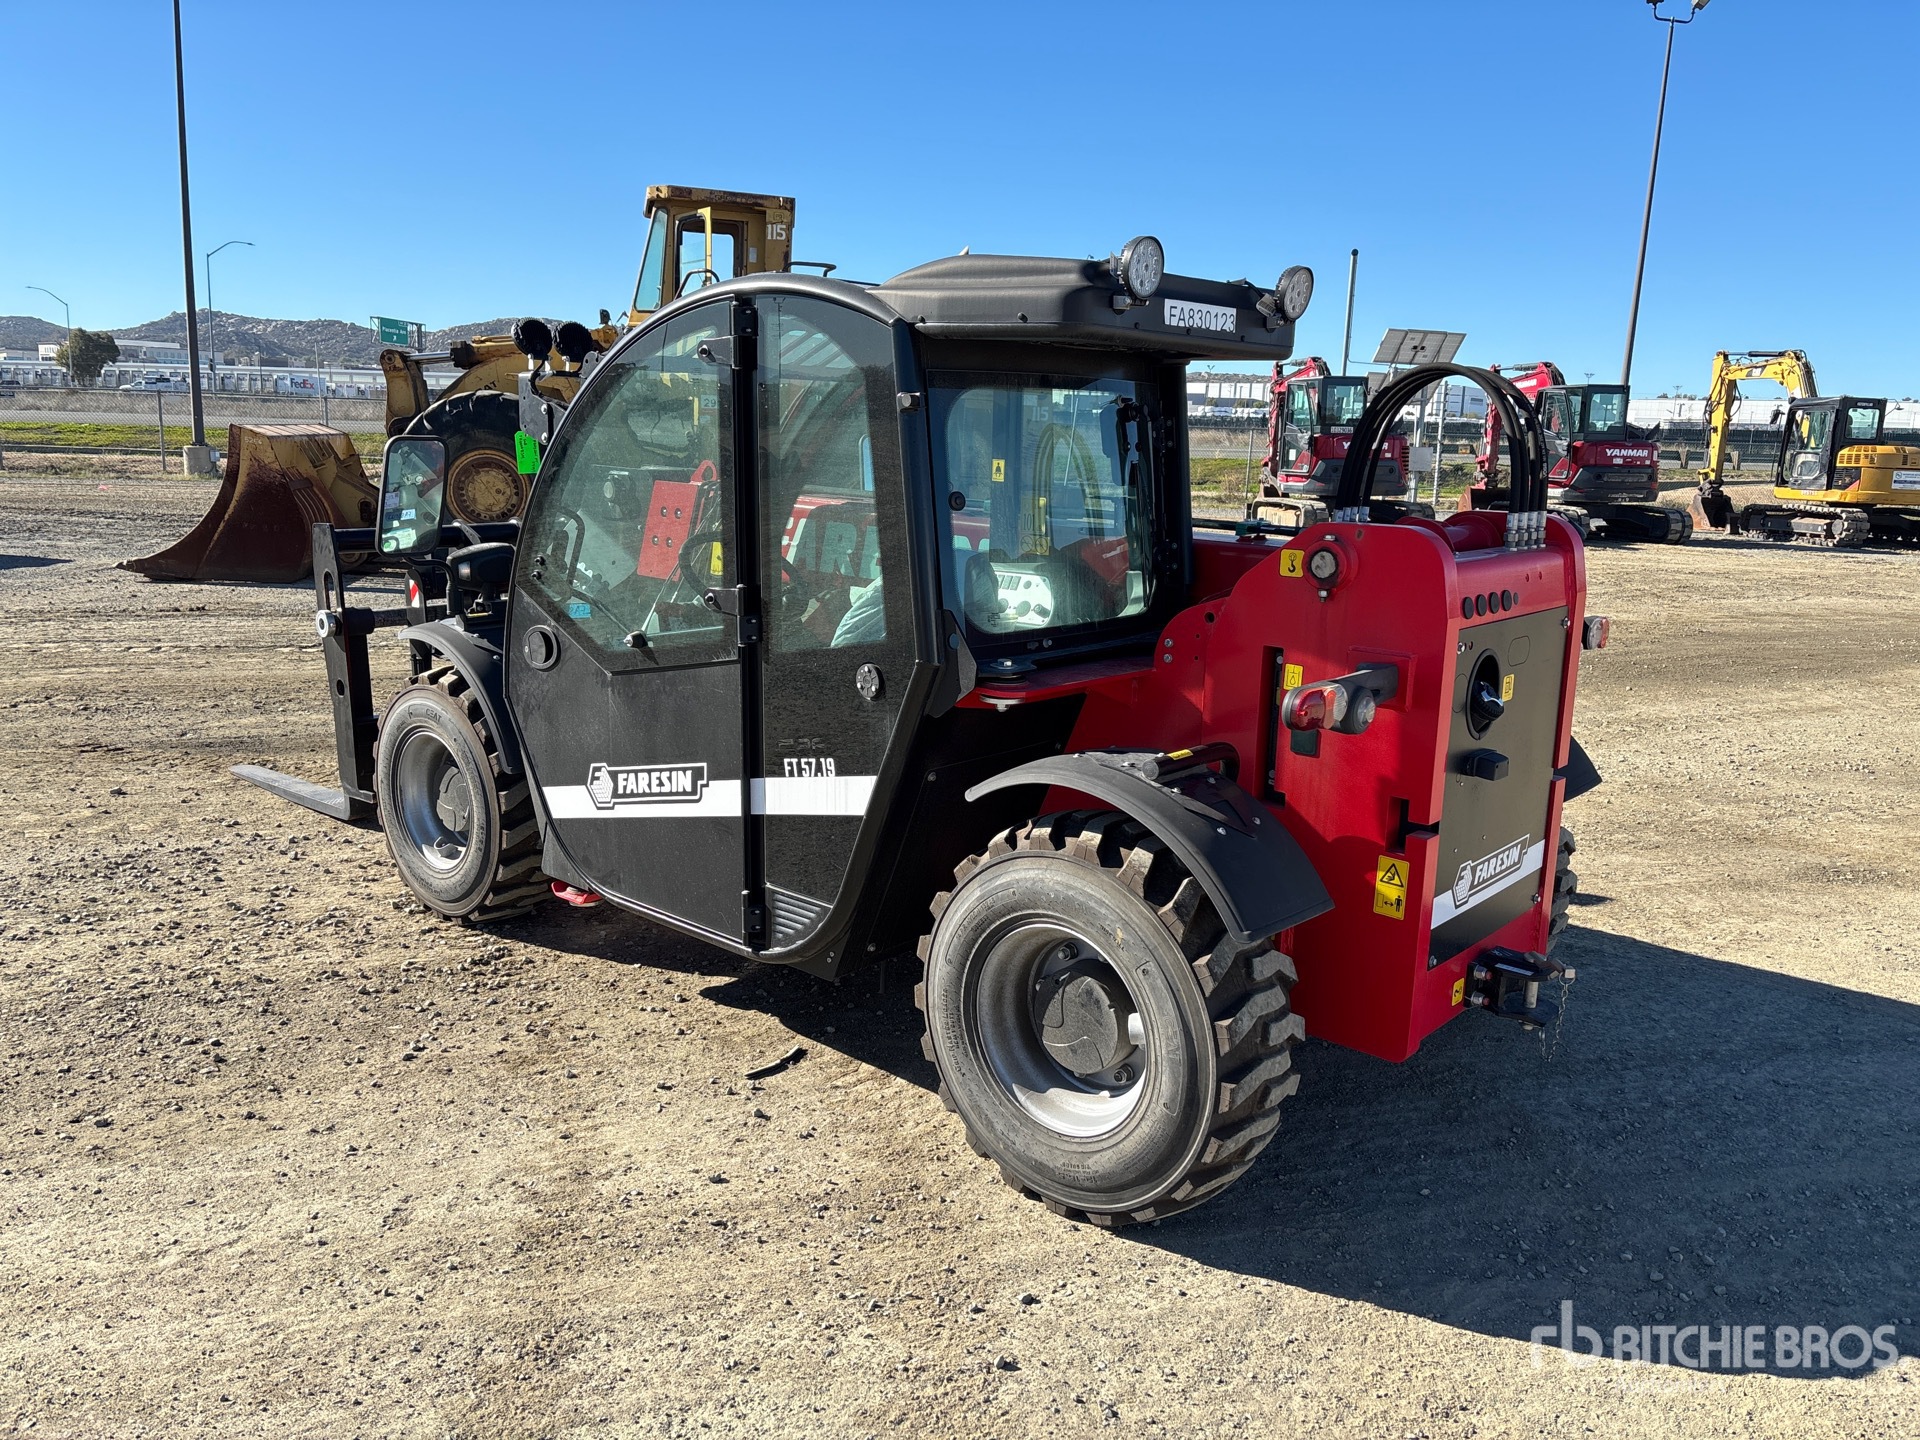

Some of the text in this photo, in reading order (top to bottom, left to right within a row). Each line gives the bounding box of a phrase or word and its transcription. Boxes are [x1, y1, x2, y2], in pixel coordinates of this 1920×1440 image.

[766, 223, 787, 240] 115
[1168, 305, 1236, 333] FA830123
[290, 378, 315, 390] FedEx
[1605, 448, 1649, 458] YANMAR
[783, 757, 836, 778] FT 57.19
[617, 769, 693, 795] FARESIN
[1473, 843, 1522, 887] FARESIN
